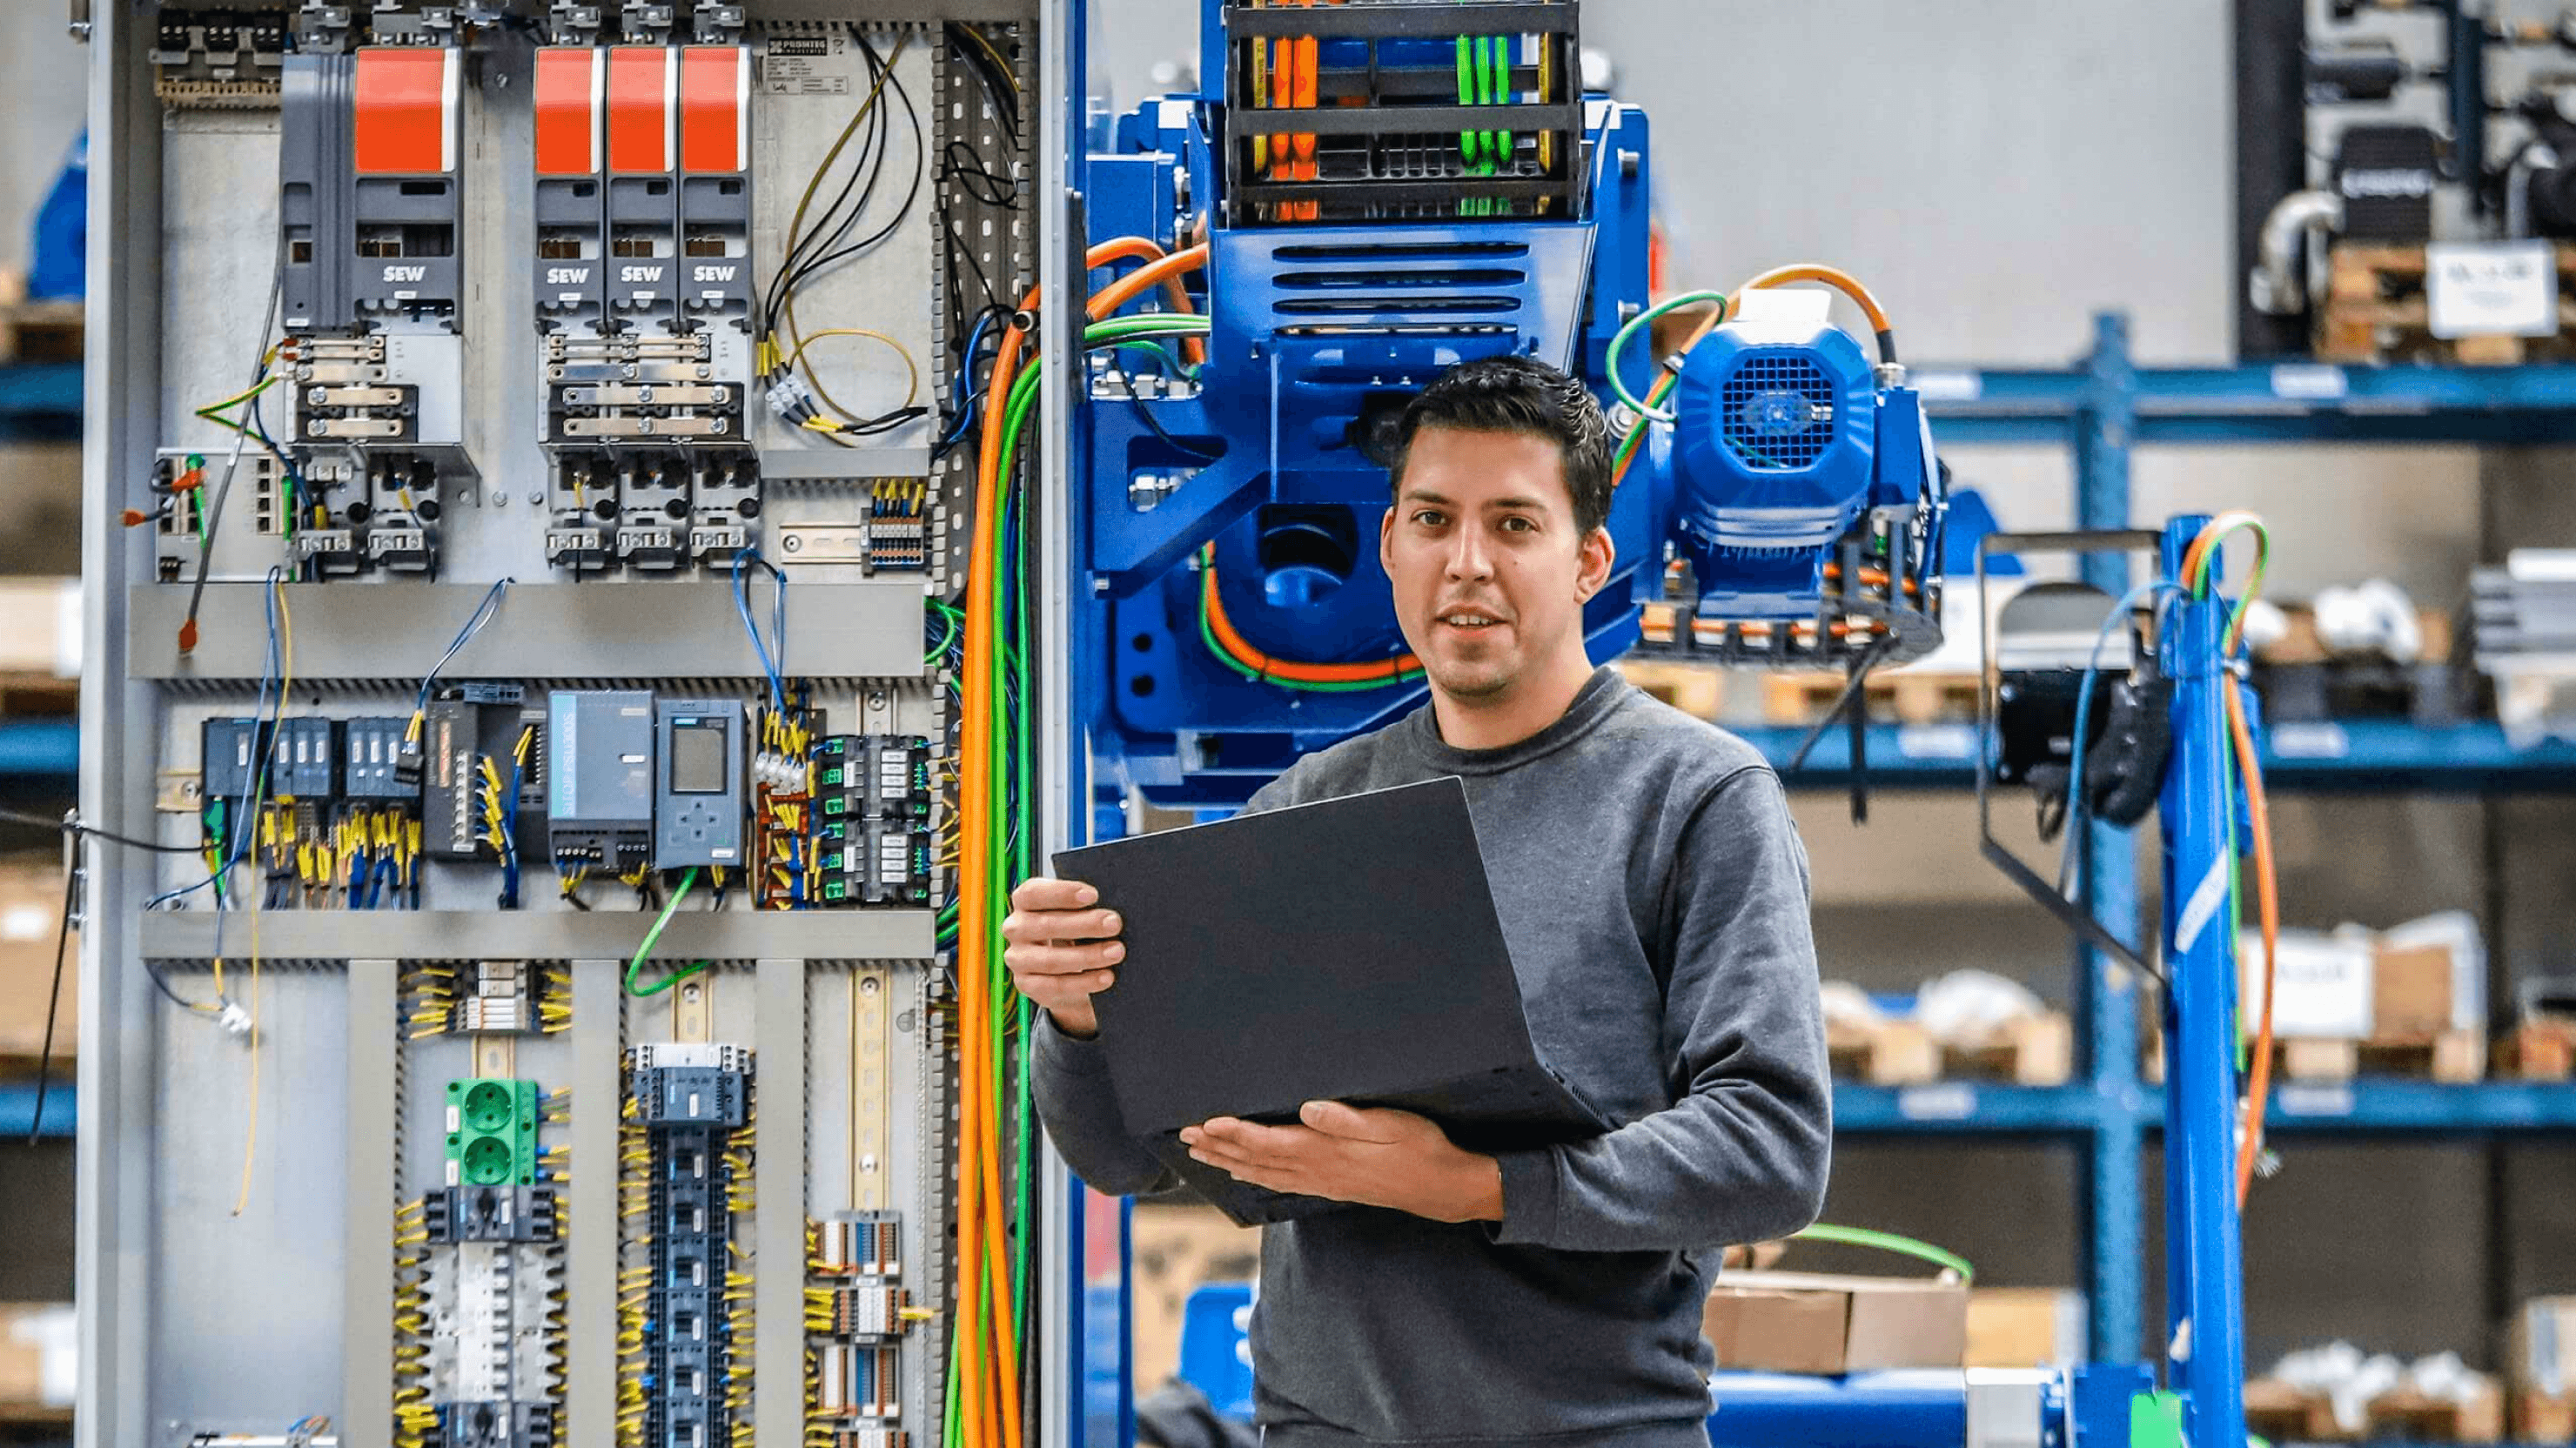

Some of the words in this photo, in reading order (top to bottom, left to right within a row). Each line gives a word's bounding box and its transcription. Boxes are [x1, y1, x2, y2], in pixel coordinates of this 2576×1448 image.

[383, 265, 426, 282] SEW
[547, 268, 589, 284] SEW
[621, 265, 663, 282] SEW
[694, 265, 736, 282] SEW
